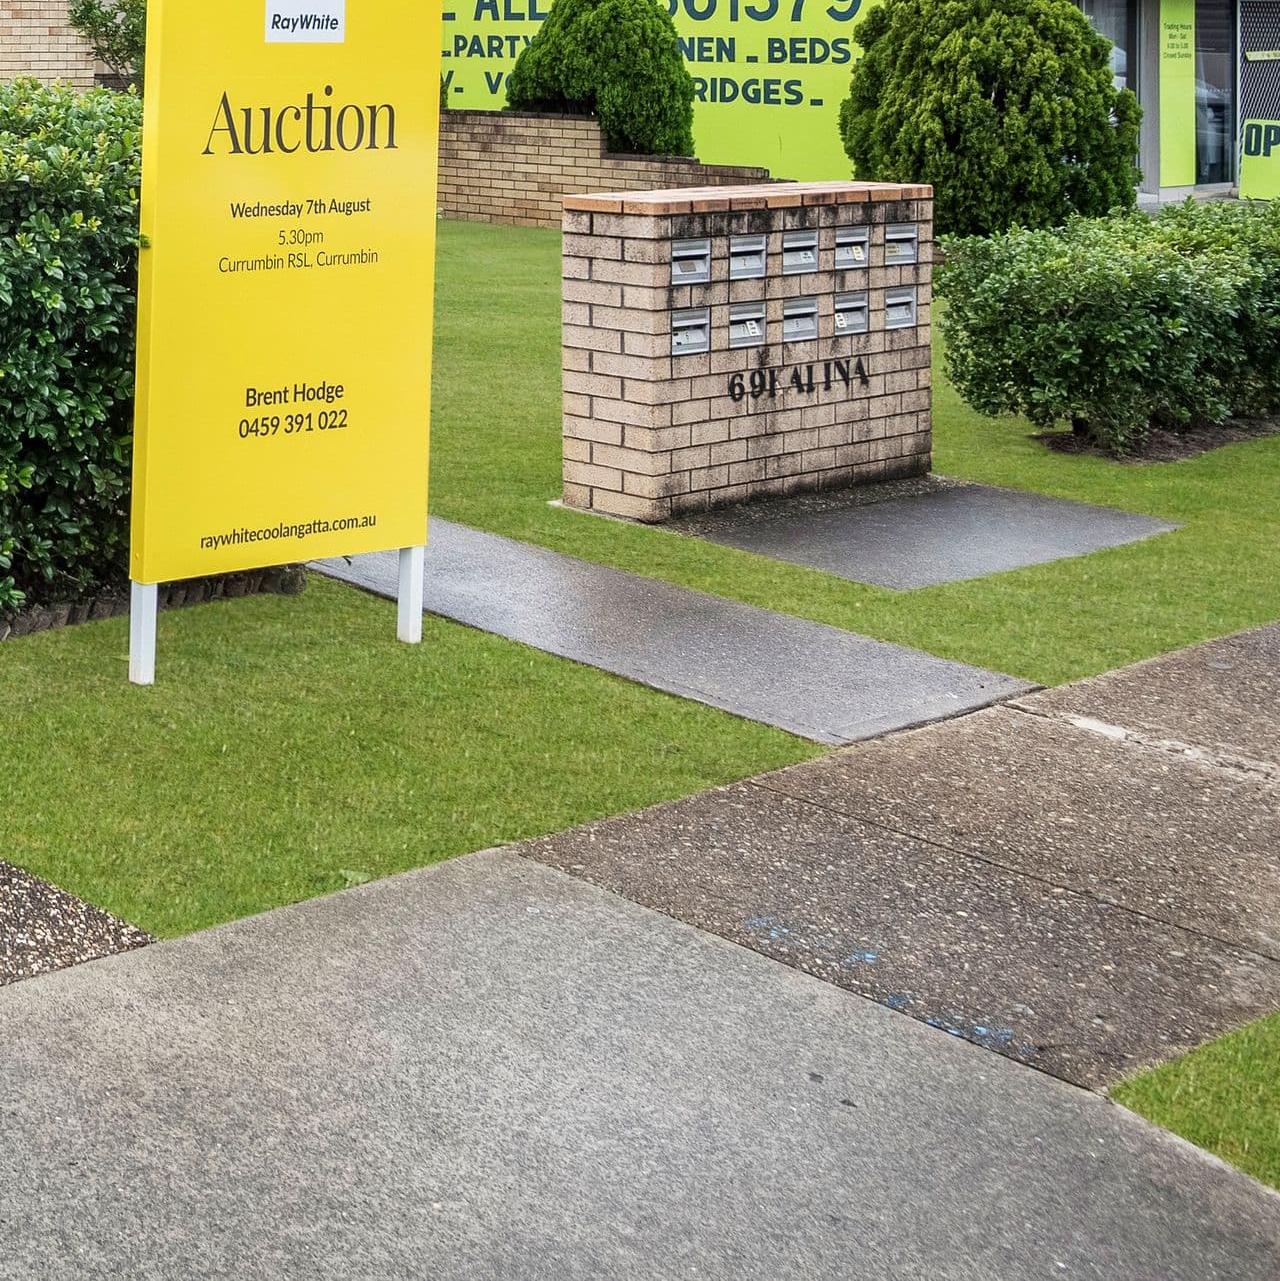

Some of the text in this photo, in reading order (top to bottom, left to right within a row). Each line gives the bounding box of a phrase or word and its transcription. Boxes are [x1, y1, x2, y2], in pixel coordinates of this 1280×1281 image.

[271, 13, 339, 33] RayWhite
[201, 84, 399, 155] Auction
[230, 197, 371, 219] Wednesday 7th August
[277, 228, 324, 248] 5.30pm
[218, 248, 378, 273] Currumbin RSL, Currumbin
[245, 380, 345, 408] Brent Hodge
[238, 408, 348, 439] 0459 391 022
[200, 514, 377, 551] raywhitecoolangatta.com.au
